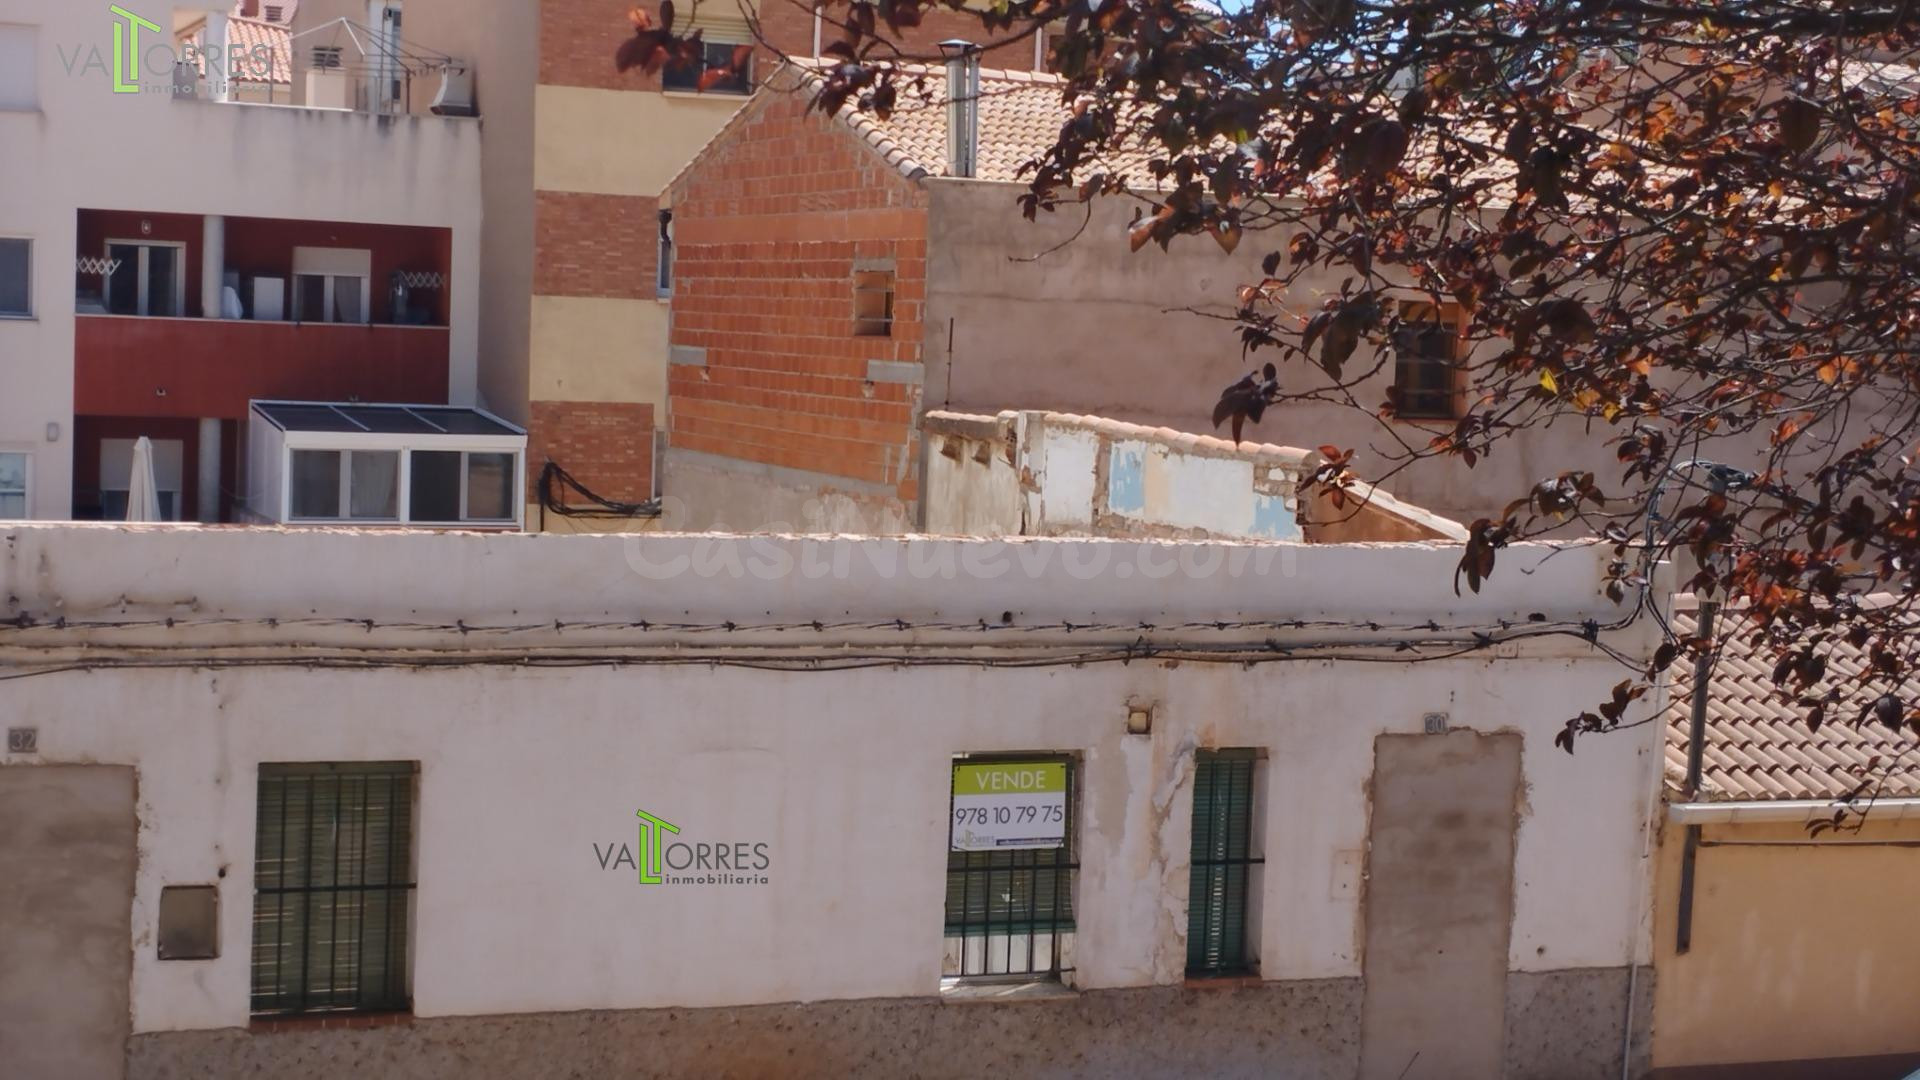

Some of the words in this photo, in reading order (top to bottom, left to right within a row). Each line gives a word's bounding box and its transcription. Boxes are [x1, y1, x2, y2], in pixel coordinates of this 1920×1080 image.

[1427, 716, 1444, 733] 30
[11, 731, 35, 750] 32
[975, 770, 1047, 790] VENDE
[955, 808, 988, 826] 978
[993, 806, 1011, 825] 10
[1015, 805, 1037, 824] 79
[1041, 804, 1064, 823] 75
